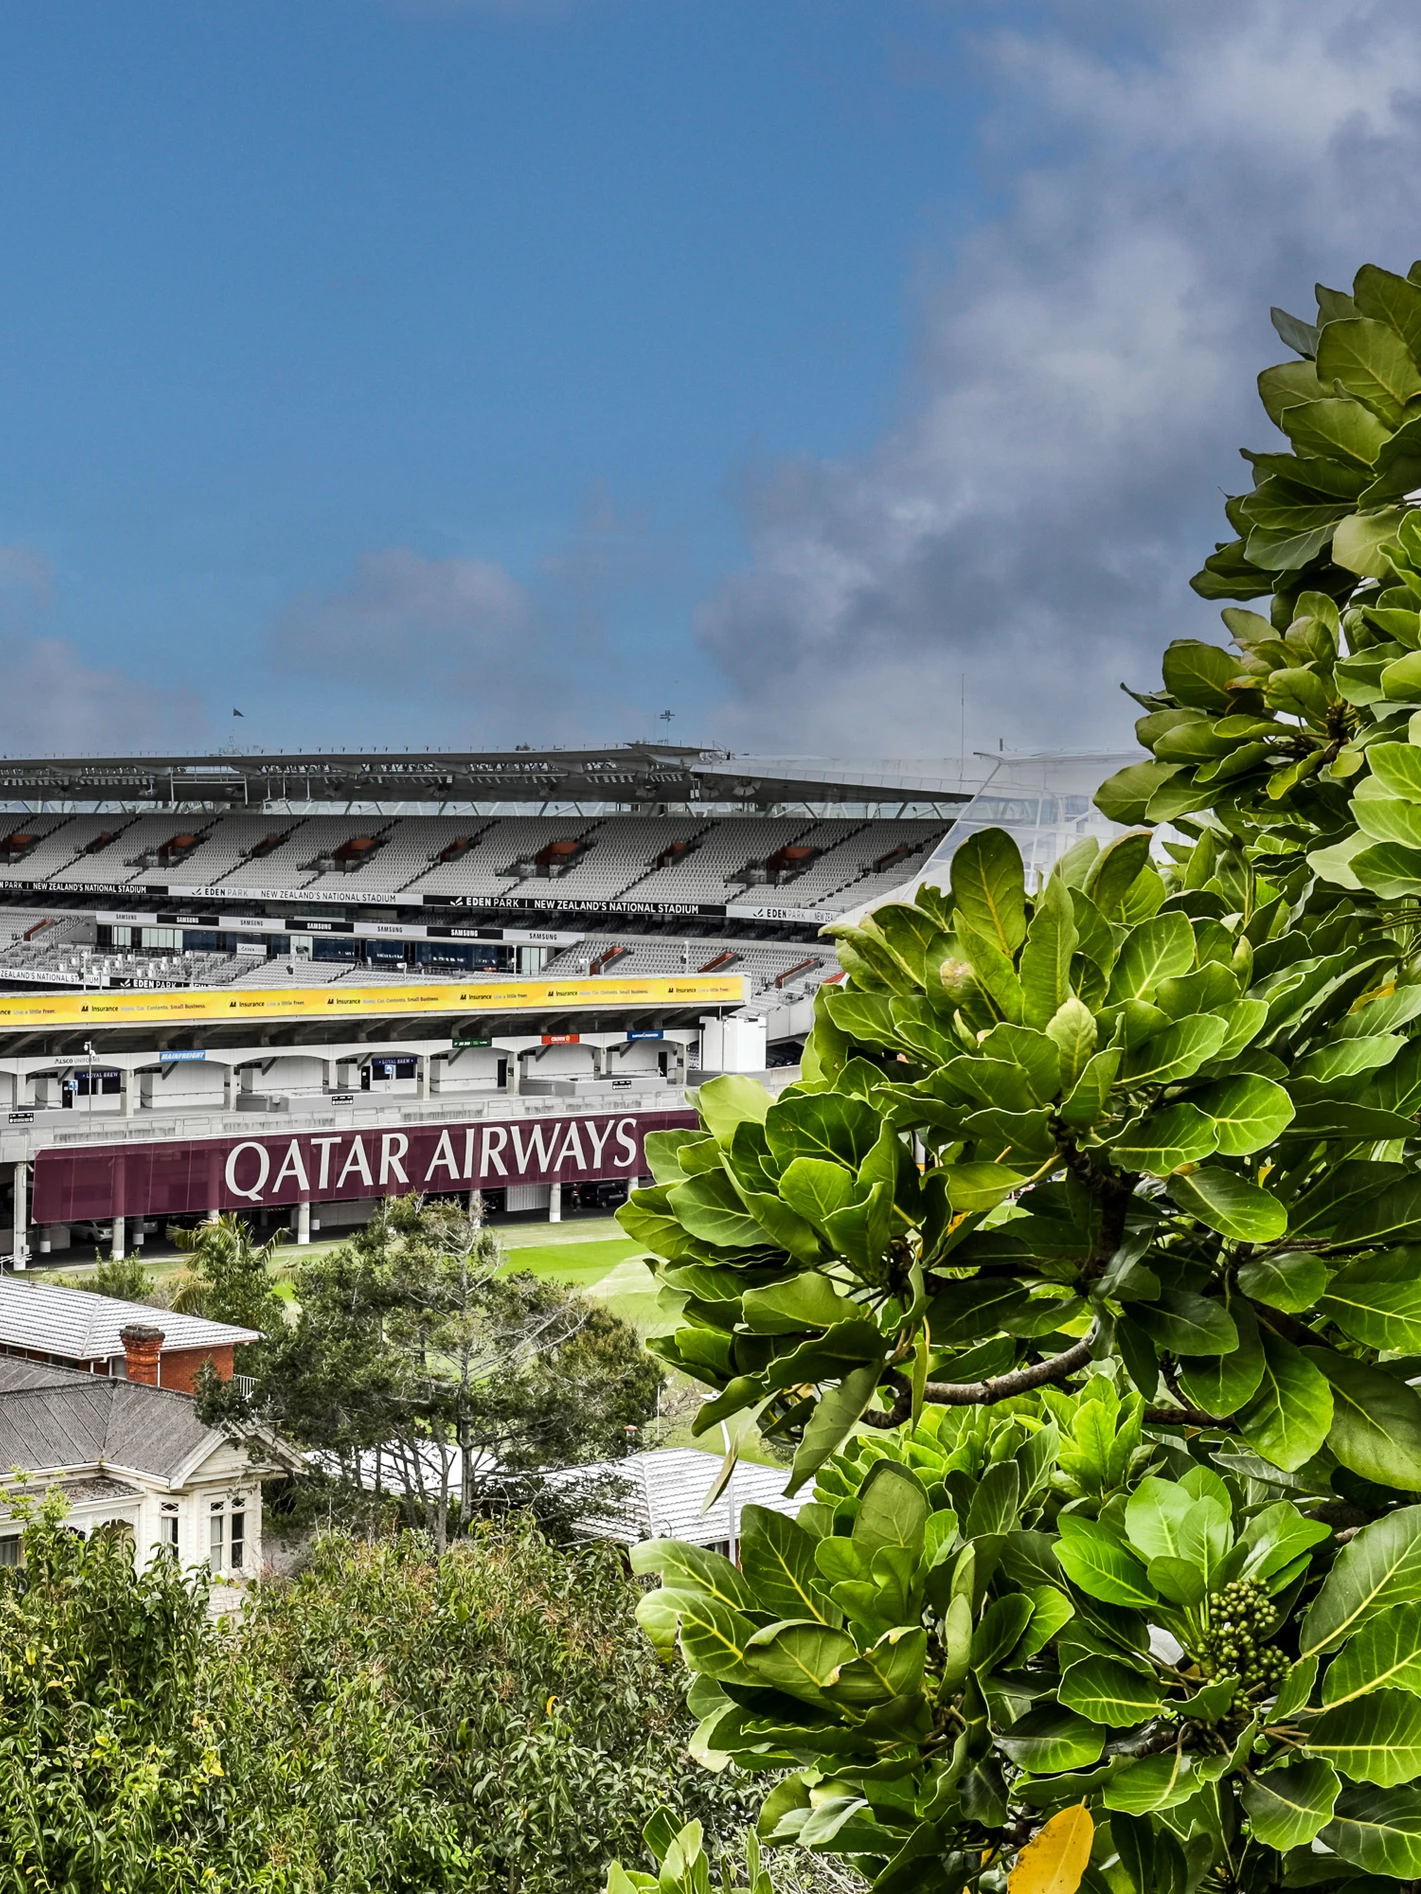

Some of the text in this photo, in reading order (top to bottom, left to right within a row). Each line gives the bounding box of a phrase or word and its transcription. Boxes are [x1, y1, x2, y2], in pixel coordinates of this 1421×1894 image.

[4, 881, 23, 889] PARK
[33, 882, 48, 890] NEW
[49, 882, 84, 891] ZEALAND'S
[84, 883, 116, 893] NATIONAL
[117, 885, 147, 894] STADIUM
[204, 888, 396, 902] EDEN PARK NEW ZEALAND'S NATIONAL STADIUM
[466, 897, 699, 914] EDEN PARK NEW ZEALAND'S NATIONAL STADIUM
[766, 909, 787, 918] EDEN
[307, 922, 332, 930] SAMSUNG
[450, 929, 478, 937] SAMSUNG
[529, 932, 558, 940] SAMSUNG
[0, 969, 36, 979] ZEALAND'S
[36, 972, 70, 982] NATIONAL
[133, 980, 177, 989] EDEN PARK
[224, 1117, 638, 1201] QATAR AIRWAYS
